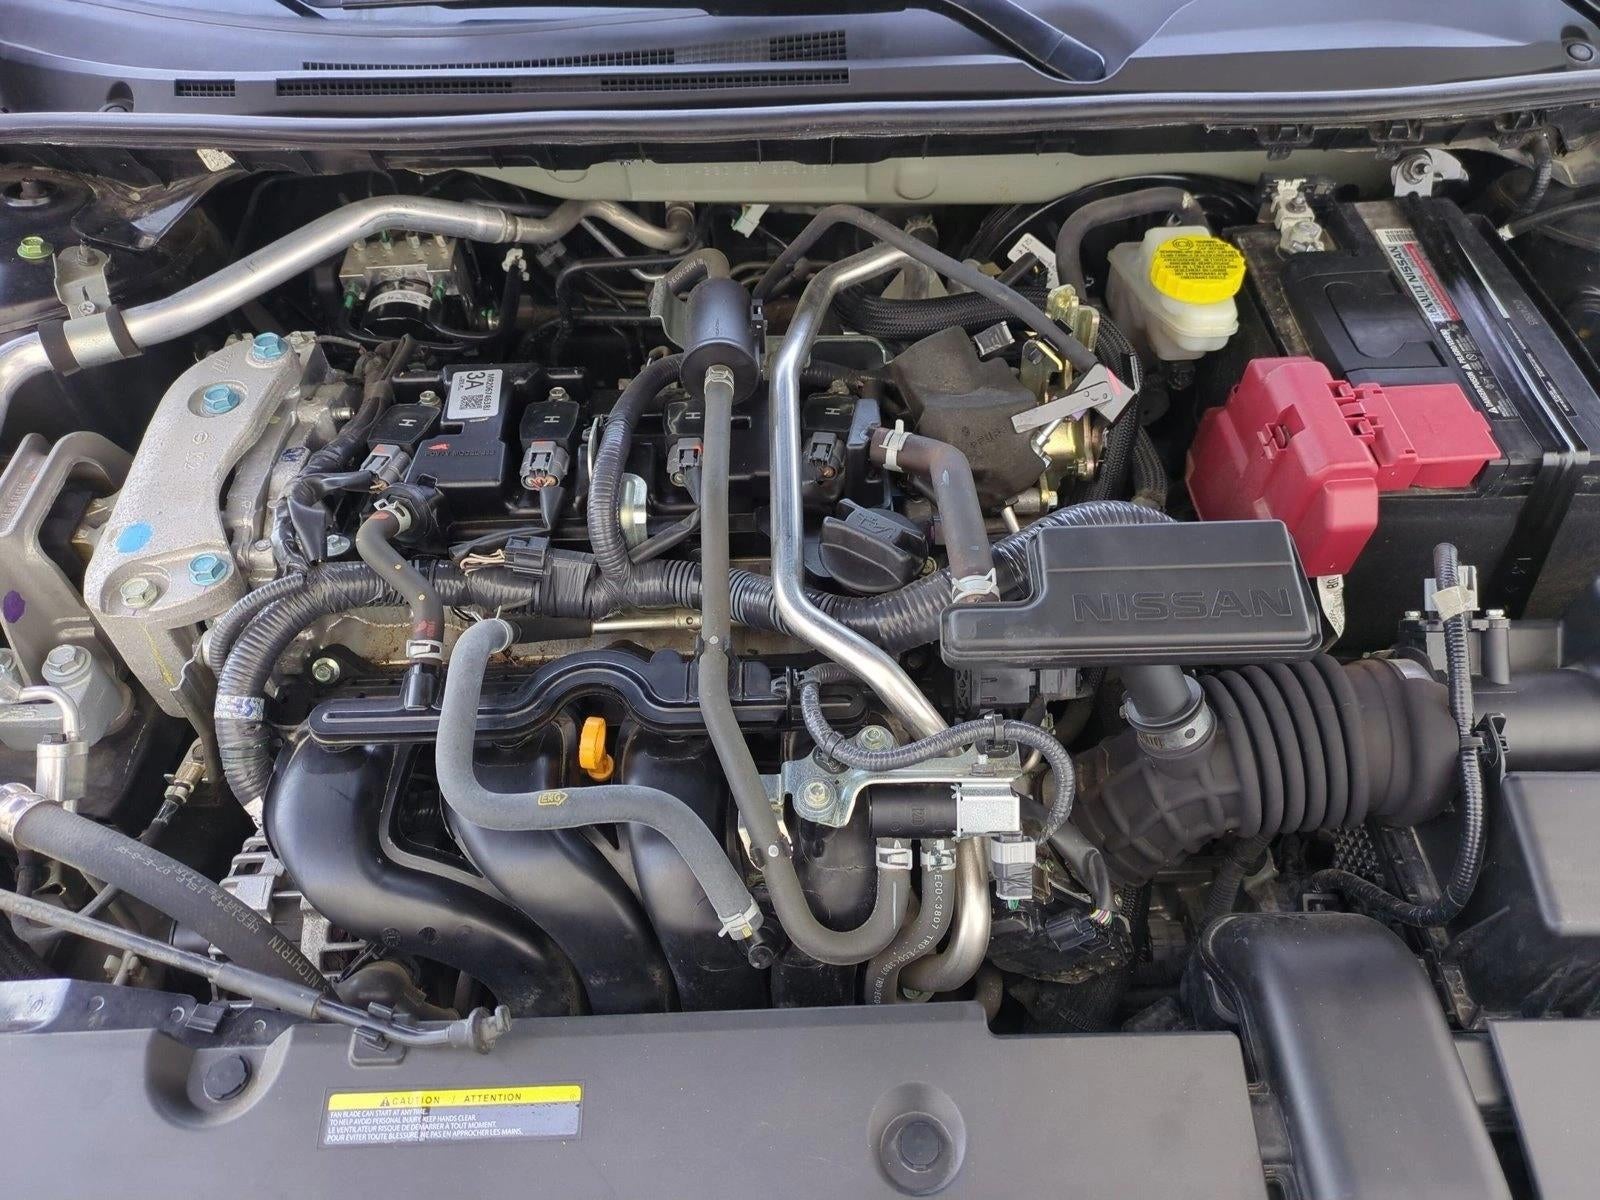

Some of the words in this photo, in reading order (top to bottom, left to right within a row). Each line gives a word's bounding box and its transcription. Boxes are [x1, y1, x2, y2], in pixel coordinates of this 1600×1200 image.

[1388, 244, 1419, 284] NISSAN
[464, 371, 486, 391] 3A
[1071, 586, 1294, 623] NISSAN
[267, 934, 320, 989] NICHIRIN
[392, 1096, 440, 1105] CAUTION
[464, 1093, 522, 1103] ATTENTION
[330, 1111, 343, 1119] FAN
[343, 1110, 361, 1118] BLADE
[361, 1109, 375, 1118] CAN
[375, 1109, 392, 1117] START
[392, 1108, 400, 1116] AT
[330, 1118, 338, 1126] TO
[353, 1117, 372, 1125] AVOID
[372, 1115, 402, 1125] PERSONAL
[422, 1114, 438, 1123] KEEP
[438, 1113, 458, 1122] HANDS
[328, 1126, 336, 1134] LE
[377, 1123, 402, 1133] RISQUE
[401, 1122, 411, 1131] DE
[450, 1119, 468, 1130] TOUT
[327, 1133, 345, 1142] POUR
[366, 1131, 389, 1141] TOUTE
[419, 1129, 430, 1138] NE
[429, 1129, 442, 1139] PAS
[442, 1128, 452, 1138] EN
[451, 1128, 490, 1137] APPROCHER
[489, 1127, 501, 1136] LES
